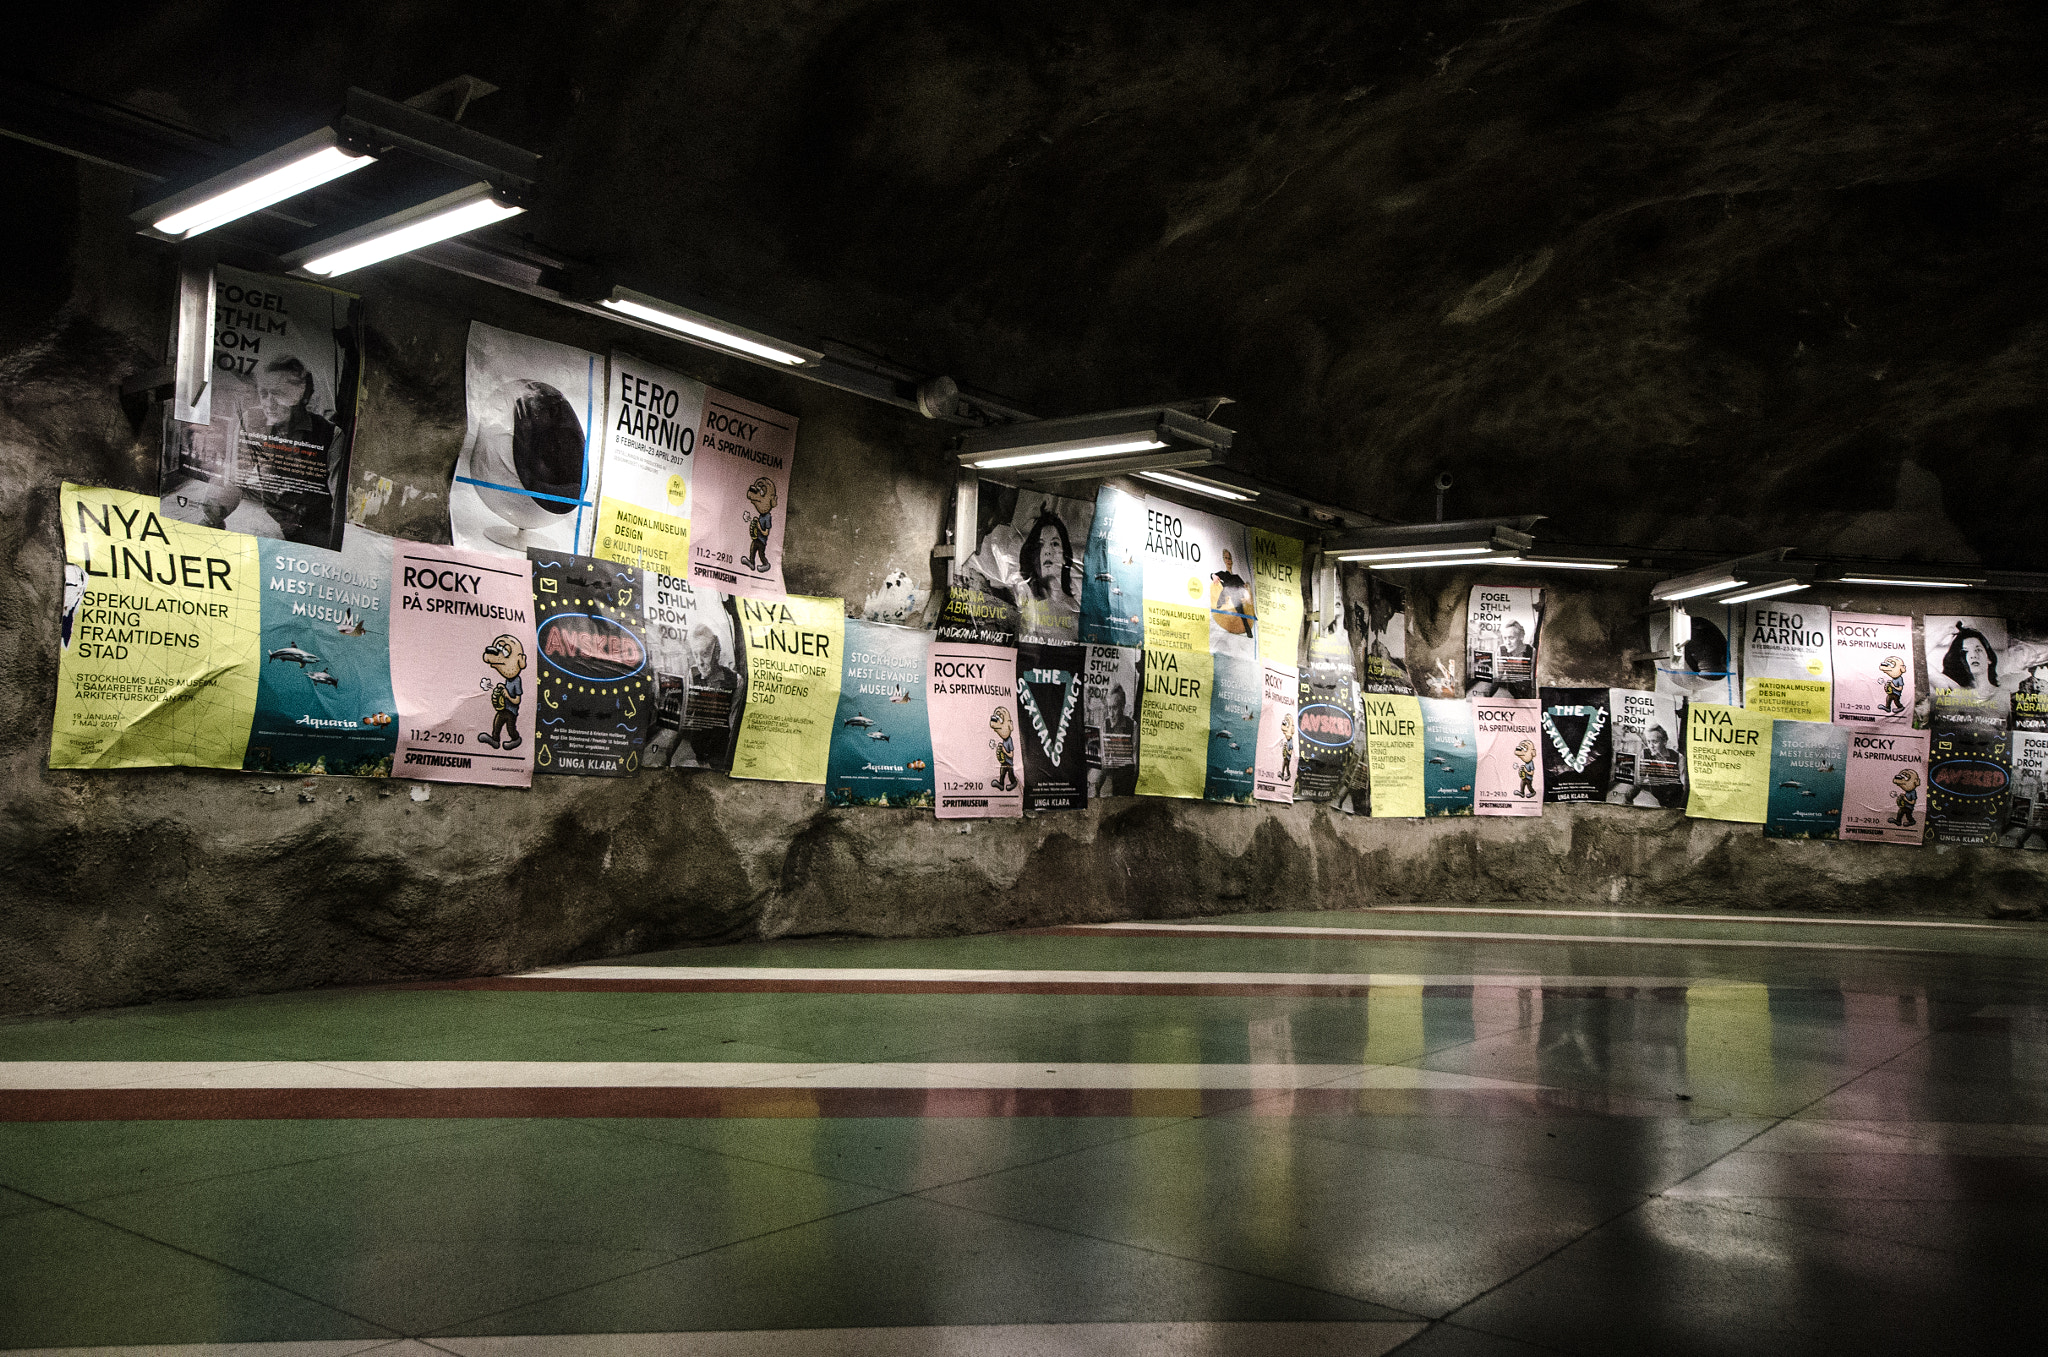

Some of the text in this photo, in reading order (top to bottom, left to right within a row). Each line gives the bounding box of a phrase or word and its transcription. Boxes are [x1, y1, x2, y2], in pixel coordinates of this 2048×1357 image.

[622, 371, 679, 419] EERO
[617, 403, 695, 456] AARNIO
[707, 411, 758, 441] ROCKY
[655, 449, 670, 462] APRIL
[670, 455, 684, 465] 2017
[702, 433, 783, 470] PÅ SPRITMUSEUM
[77, 501, 170, 545] NYA
[617, 510, 687, 537] NATIONALMUSEUM
[1148, 509, 1182, 538] EERO
[615, 524, 643, 540] DESIGN
[613, 539, 668, 561] KULTURHUSET
[1145, 531, 1201, 563] AARNIO
[1255, 536, 1278, 559] NYA
[83, 542, 233, 591] LINJER
[275, 556, 379, 590] STOCKHOLMS
[694, 566, 738, 584] SPRITMUSEUM
[1256, 557, 1293, 583] LINJER
[403, 566, 481, 595] ROCKY
[657, 573, 694, 594] FOGEL
[269, 576, 380, 611] MEST LEVANDE
[657, 591, 697, 610] STHLM
[1481, 593, 1510, 602] FOGEL
[82, 591, 229, 618] SPEKULATIONER
[402, 592, 525, 623] PÅ SPRITMUSEUM
[743, 598, 797, 626] NYA
[1480, 603, 1511, 612] STHLM
[81, 609, 140, 627] KRING
[292, 601, 360, 626] MUSEUM!
[1148, 607, 1206, 622] NATIONALMUSEUM
[1148, 617, 1171, 627] DESIGN
[1755, 610, 1803, 630] EERO
[80, 626, 200, 648] FRAMTIDENS
[661, 625, 688, 642] 2017
[1752, 627, 1824, 647] AARNIO
[1837, 626, 1878, 638] ROCKY
[545, 626, 640, 667] AVSKED
[748, 625, 830, 659] LINJER
[1837, 638, 1906, 650] PÅ SPRITMUSEUM
[78, 643, 128, 660] STAD
[1091, 646, 1120, 659] FOGEL
[752, 657, 827, 677] SPEKULATIONER
[850, 652, 918, 669] STOCKHOLMS
[1090, 659, 1119, 673] STHLM
[1147, 650, 1178, 673] NYA
[753, 669, 783, 682] KRING
[848, 667, 920, 684] MEST LEVANDE
[934, 662, 985, 678] ROCKY
[1032, 668, 1061, 685] THE
[76, 673, 147, 685] STOCKHOLMS
[149, 676, 175, 687] LÄNS
[83, 683, 143, 693] SAMARBETE
[145, 685, 167, 694] MED
[752, 680, 809, 696] FRAMTIDENS
[934, 680, 1012, 697] PÅ SPRITMUSEUM
[1145, 673, 1201, 698] LINJER
[1759, 682, 1825, 693] NATIONALMUSEUM
[751, 692, 776, 705] STAD
[1624, 696, 1654, 707] FOGEL
[1759, 690, 1786, 698] DESIGN
[1143, 700, 1197, 714] SPEKULATIONER
[1367, 701, 1396, 716] NYA
[1555, 705, 1584, 717] THE
[1624, 706, 1655, 716] STHLM
[1759, 699, 1810, 707] KULTURHUSET
[1759, 706, 1811, 715] STADSTEATERN
[296, 715, 358, 729] Aquaria
[1016, 677, 1054, 758] SEXUAL
[1051, 672, 1082, 768] CONTRACT
[1142, 710, 1163, 720] KRING
[1478, 710, 1516, 721] ROCKY
[1694, 709, 1733, 726] NYA
[1141, 718, 1185, 730] FRAMTIDENS
[1141, 727, 1158, 736] STAD
[1369, 720, 1415, 736] LINJER
[1479, 723, 1537, 733] PÅ SPRITMUSEUM
[1574, 706, 1609, 773] CONTRACT
[1693, 727, 1759, 745] LINJER
[1853, 737, 1895, 750] ROCKY
[1693, 746, 1755, 757] SPEKULATIONER
[1852, 749, 1922, 763] PÅ SPRITMUSEUM
[404, 753, 471, 769] SPRITMUSEUM
[559, 757, 618, 771] UNGA KLARA
[861, 762, 904, 773] Aquaria
[1693, 760, 1742, 770] FRAMTIDENS
[1694, 767, 1712, 775] STAD
[942, 799, 989, 808] SPRITMUSEUM
